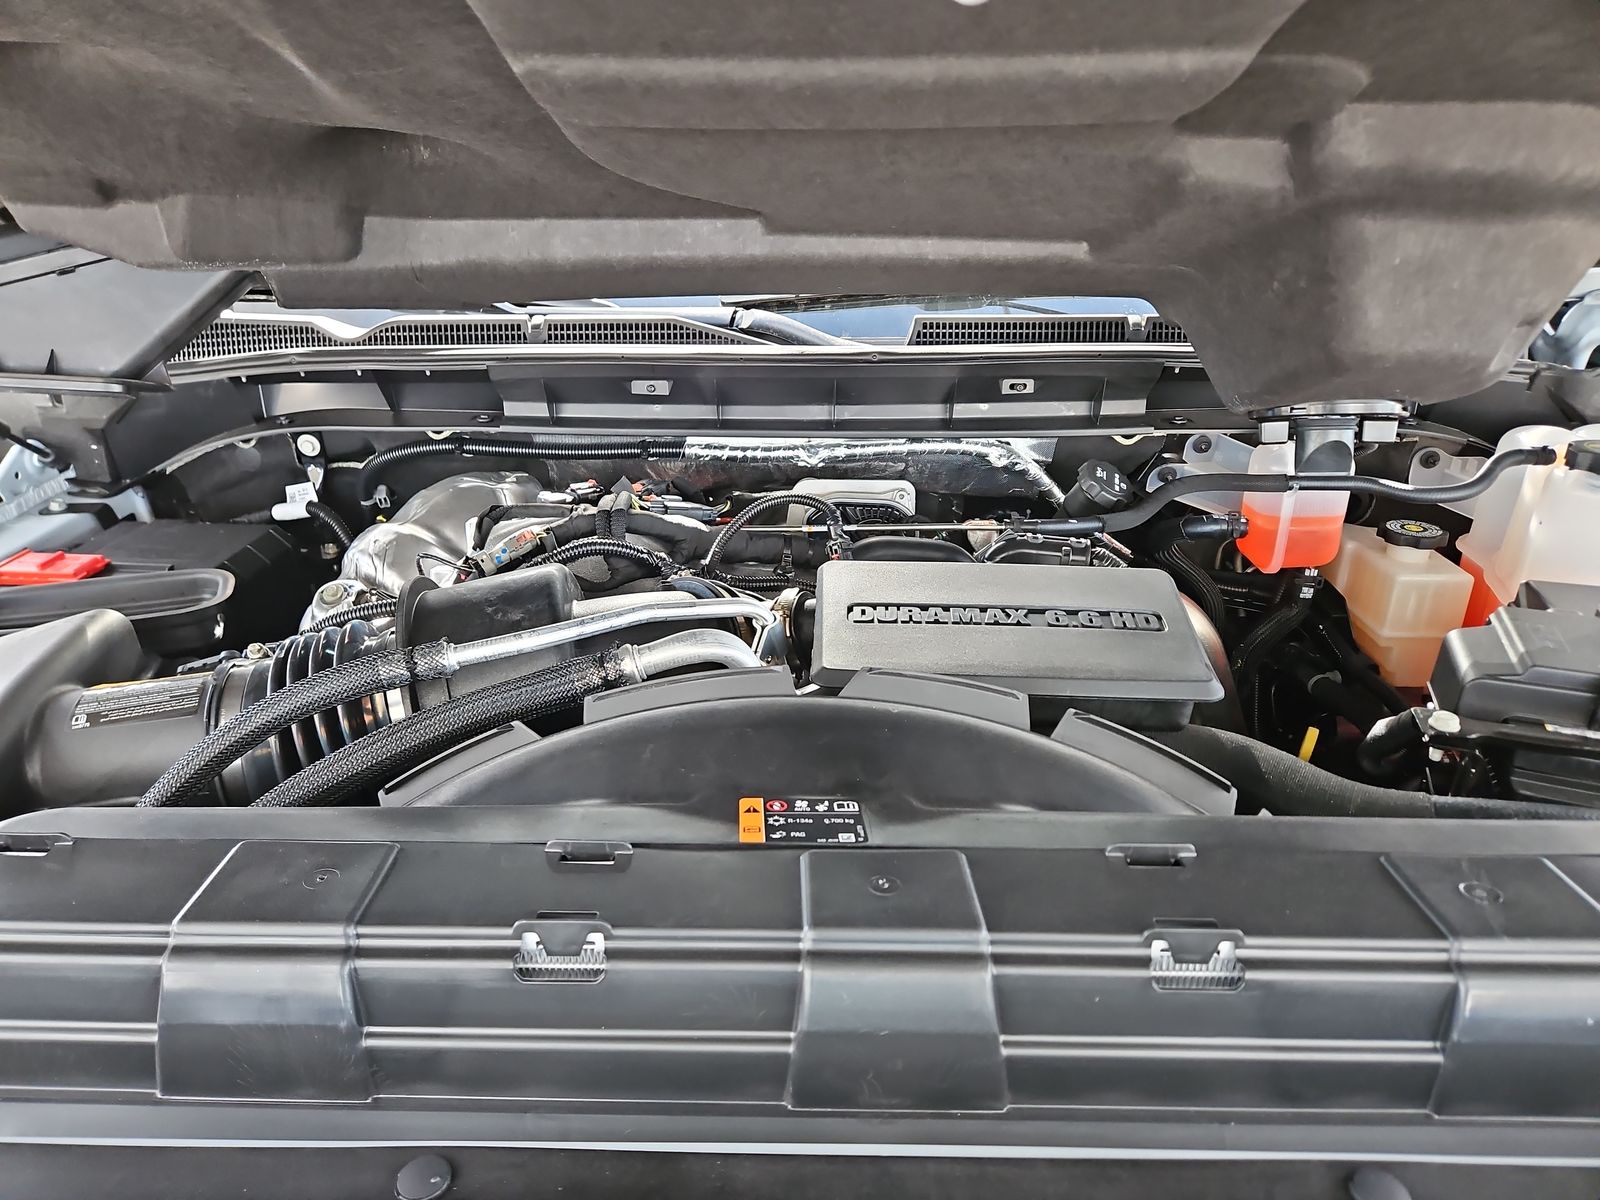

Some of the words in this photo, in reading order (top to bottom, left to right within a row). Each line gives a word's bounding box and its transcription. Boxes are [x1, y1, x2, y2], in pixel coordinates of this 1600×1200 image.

[852, 606, 1031, 626] DURAMAX
[1045, 610, 1102, 628] 6.6
[1111, 611, 1162, 630] HD
